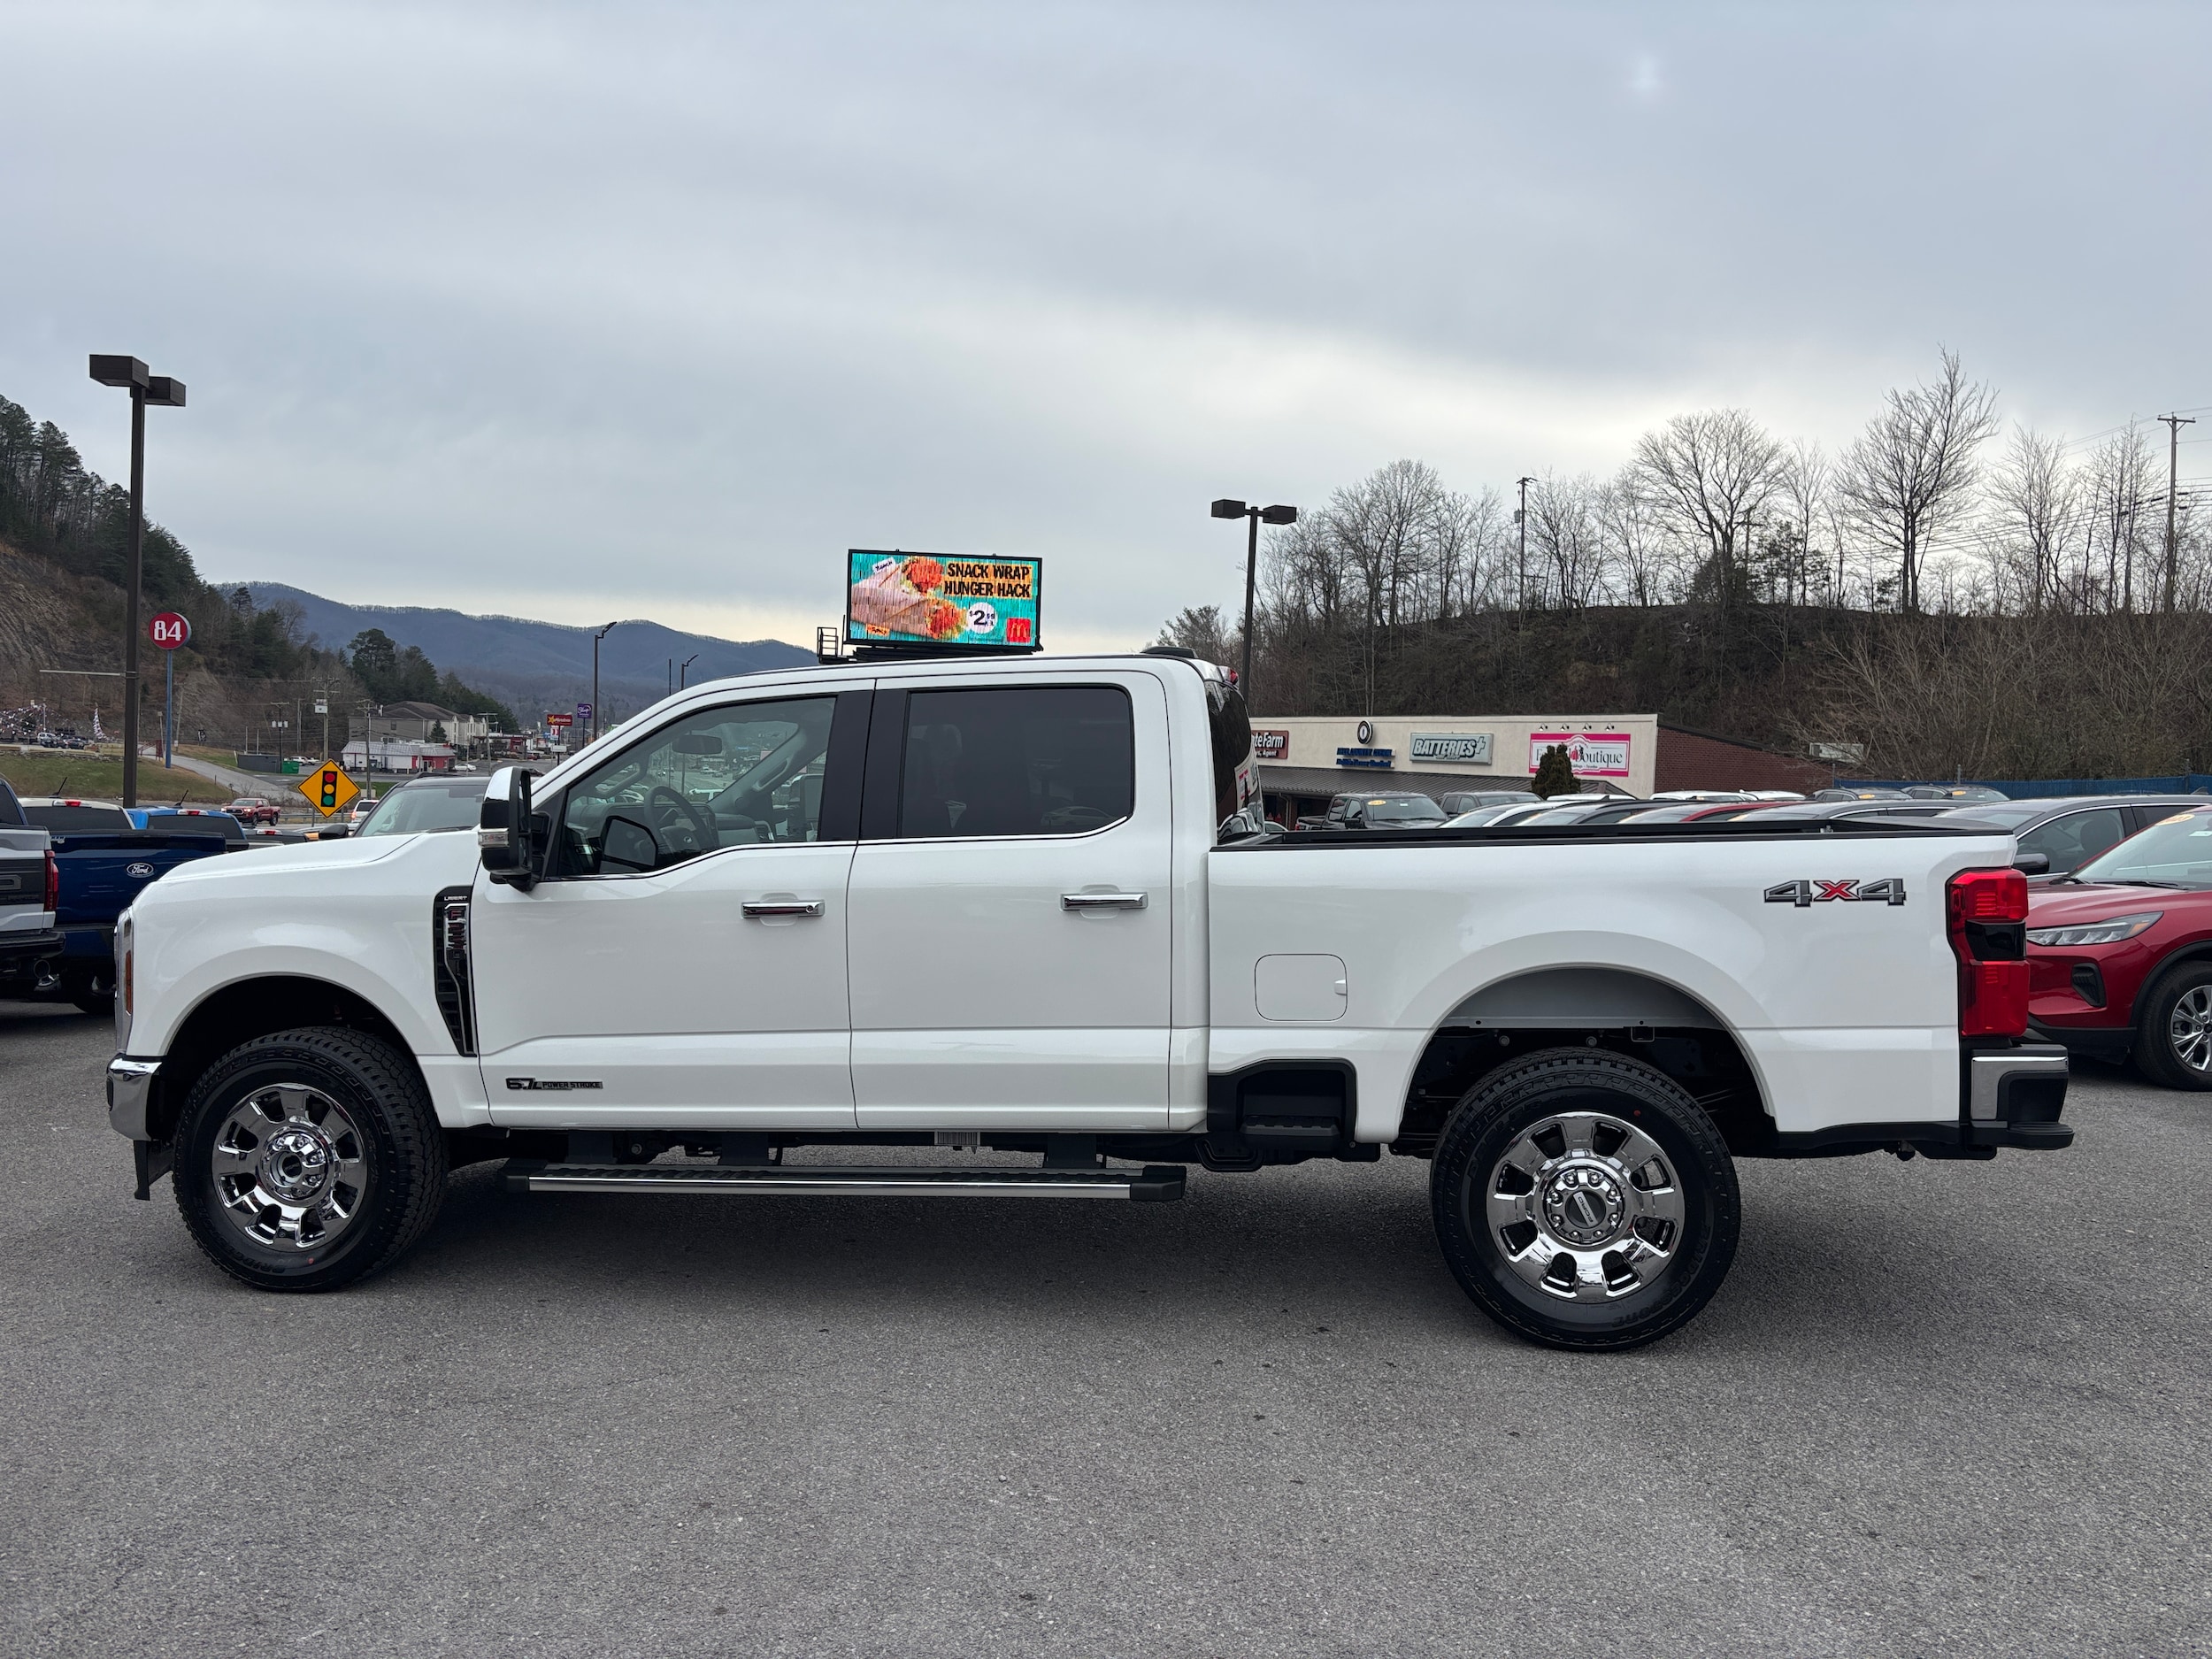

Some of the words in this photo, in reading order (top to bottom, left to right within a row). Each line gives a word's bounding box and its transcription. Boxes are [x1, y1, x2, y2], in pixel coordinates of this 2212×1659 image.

[947, 563, 989, 579] SNACK
[993, 565, 1031, 580] WRAP
[943, 580, 994, 596] HUNGER
[997, 582, 1031, 598] HACK
[154, 620, 182, 641] 84
[131, 864, 150, 876] Ford
